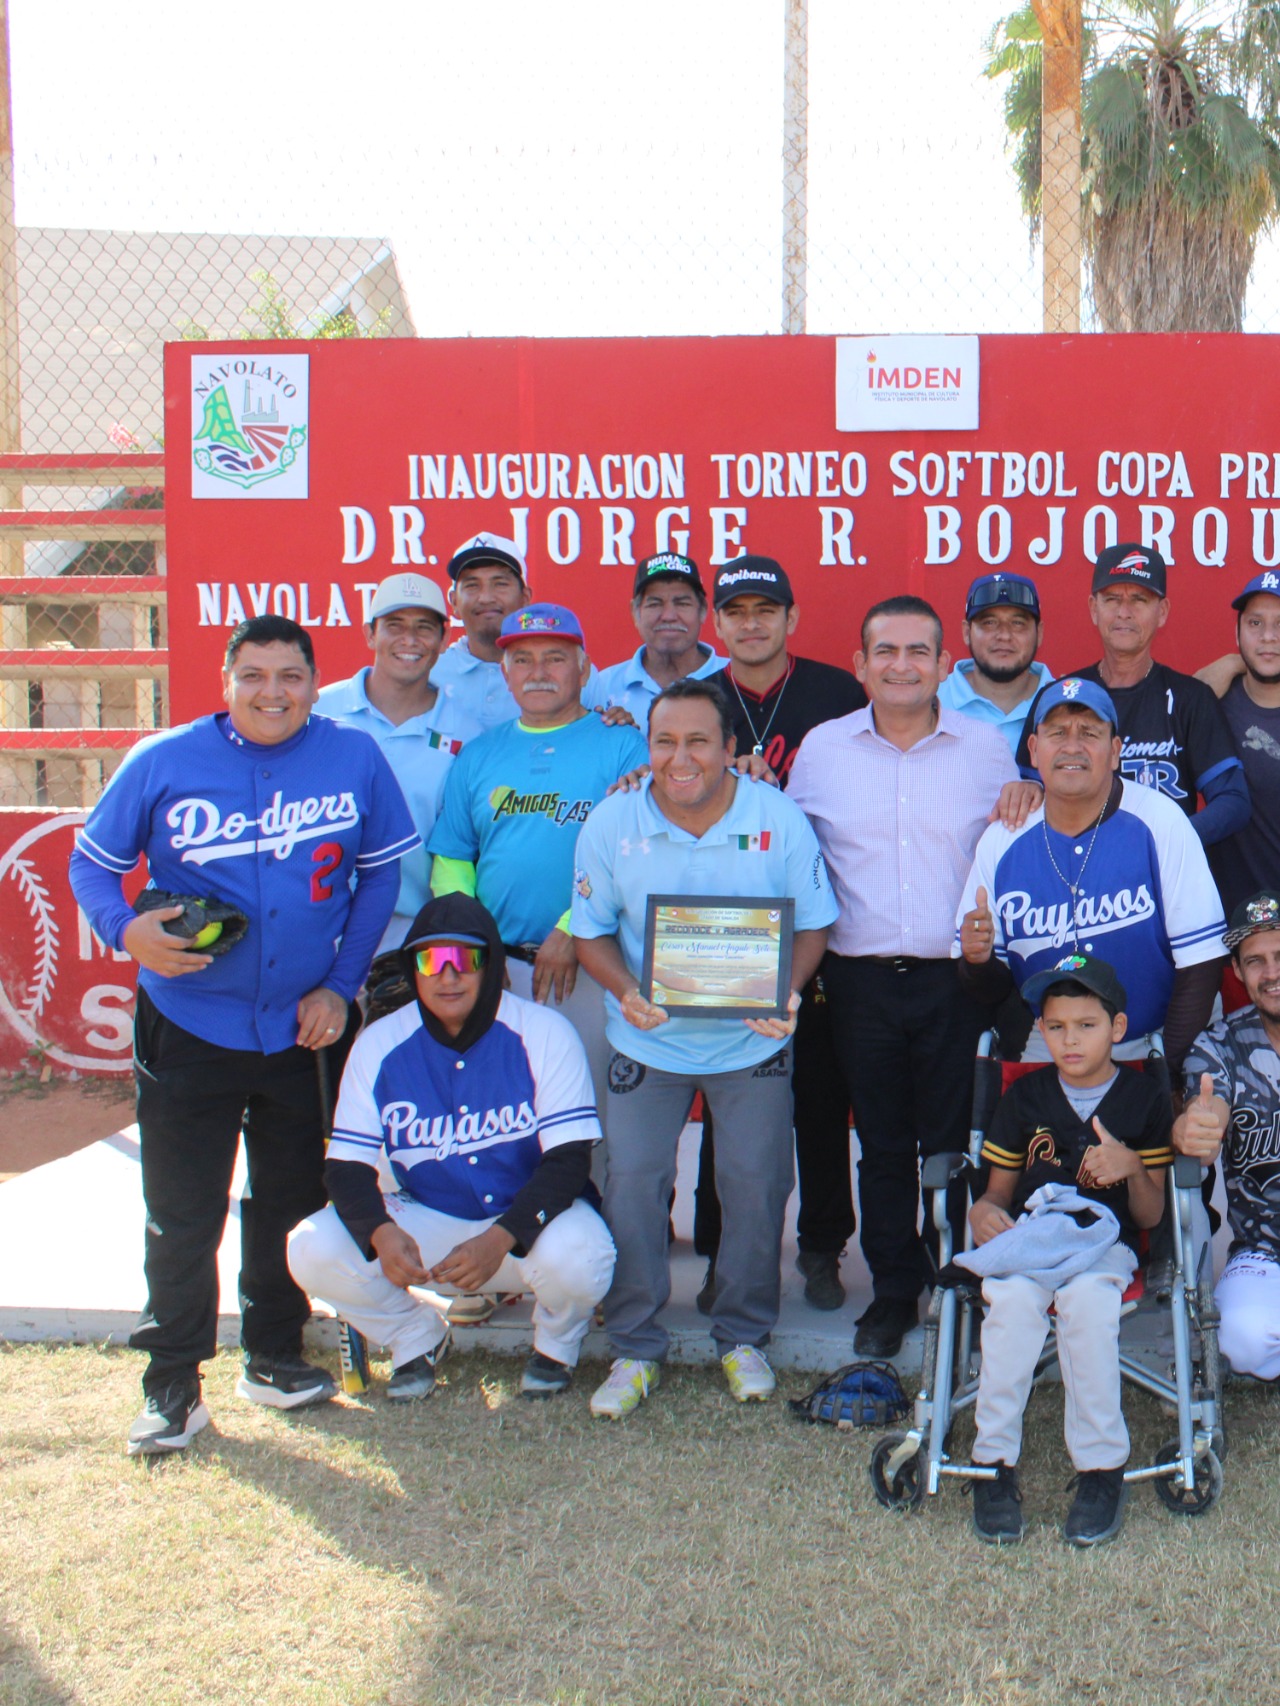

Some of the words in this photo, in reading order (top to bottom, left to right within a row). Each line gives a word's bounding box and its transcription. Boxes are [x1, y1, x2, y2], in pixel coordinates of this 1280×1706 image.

[194, 360, 297, 400] NAVOLATO
[868, 367, 961, 389] IMDEN
[408, 453, 685, 500] INAUGURACION
[710, 451, 868, 499] TORNEO
[892, 450, 1077, 499] SOFTBOL
[1097, 450, 1195, 498] COPA
[339, 505, 438, 566] DR.
[819, 506, 868, 567] R.
[718, 569, 777, 586] Capibaras
[1261, 572, 1279, 588] LA
[196, 582, 378, 628] NAVOLAT
[167, 791, 360, 858] Dodgers
[493, 790, 560, 821] AMIGOS
[311, 843, 342, 901] 2
[998, 883, 1156, 947] Payasos
[381, 1100, 537, 1162] Payasos
